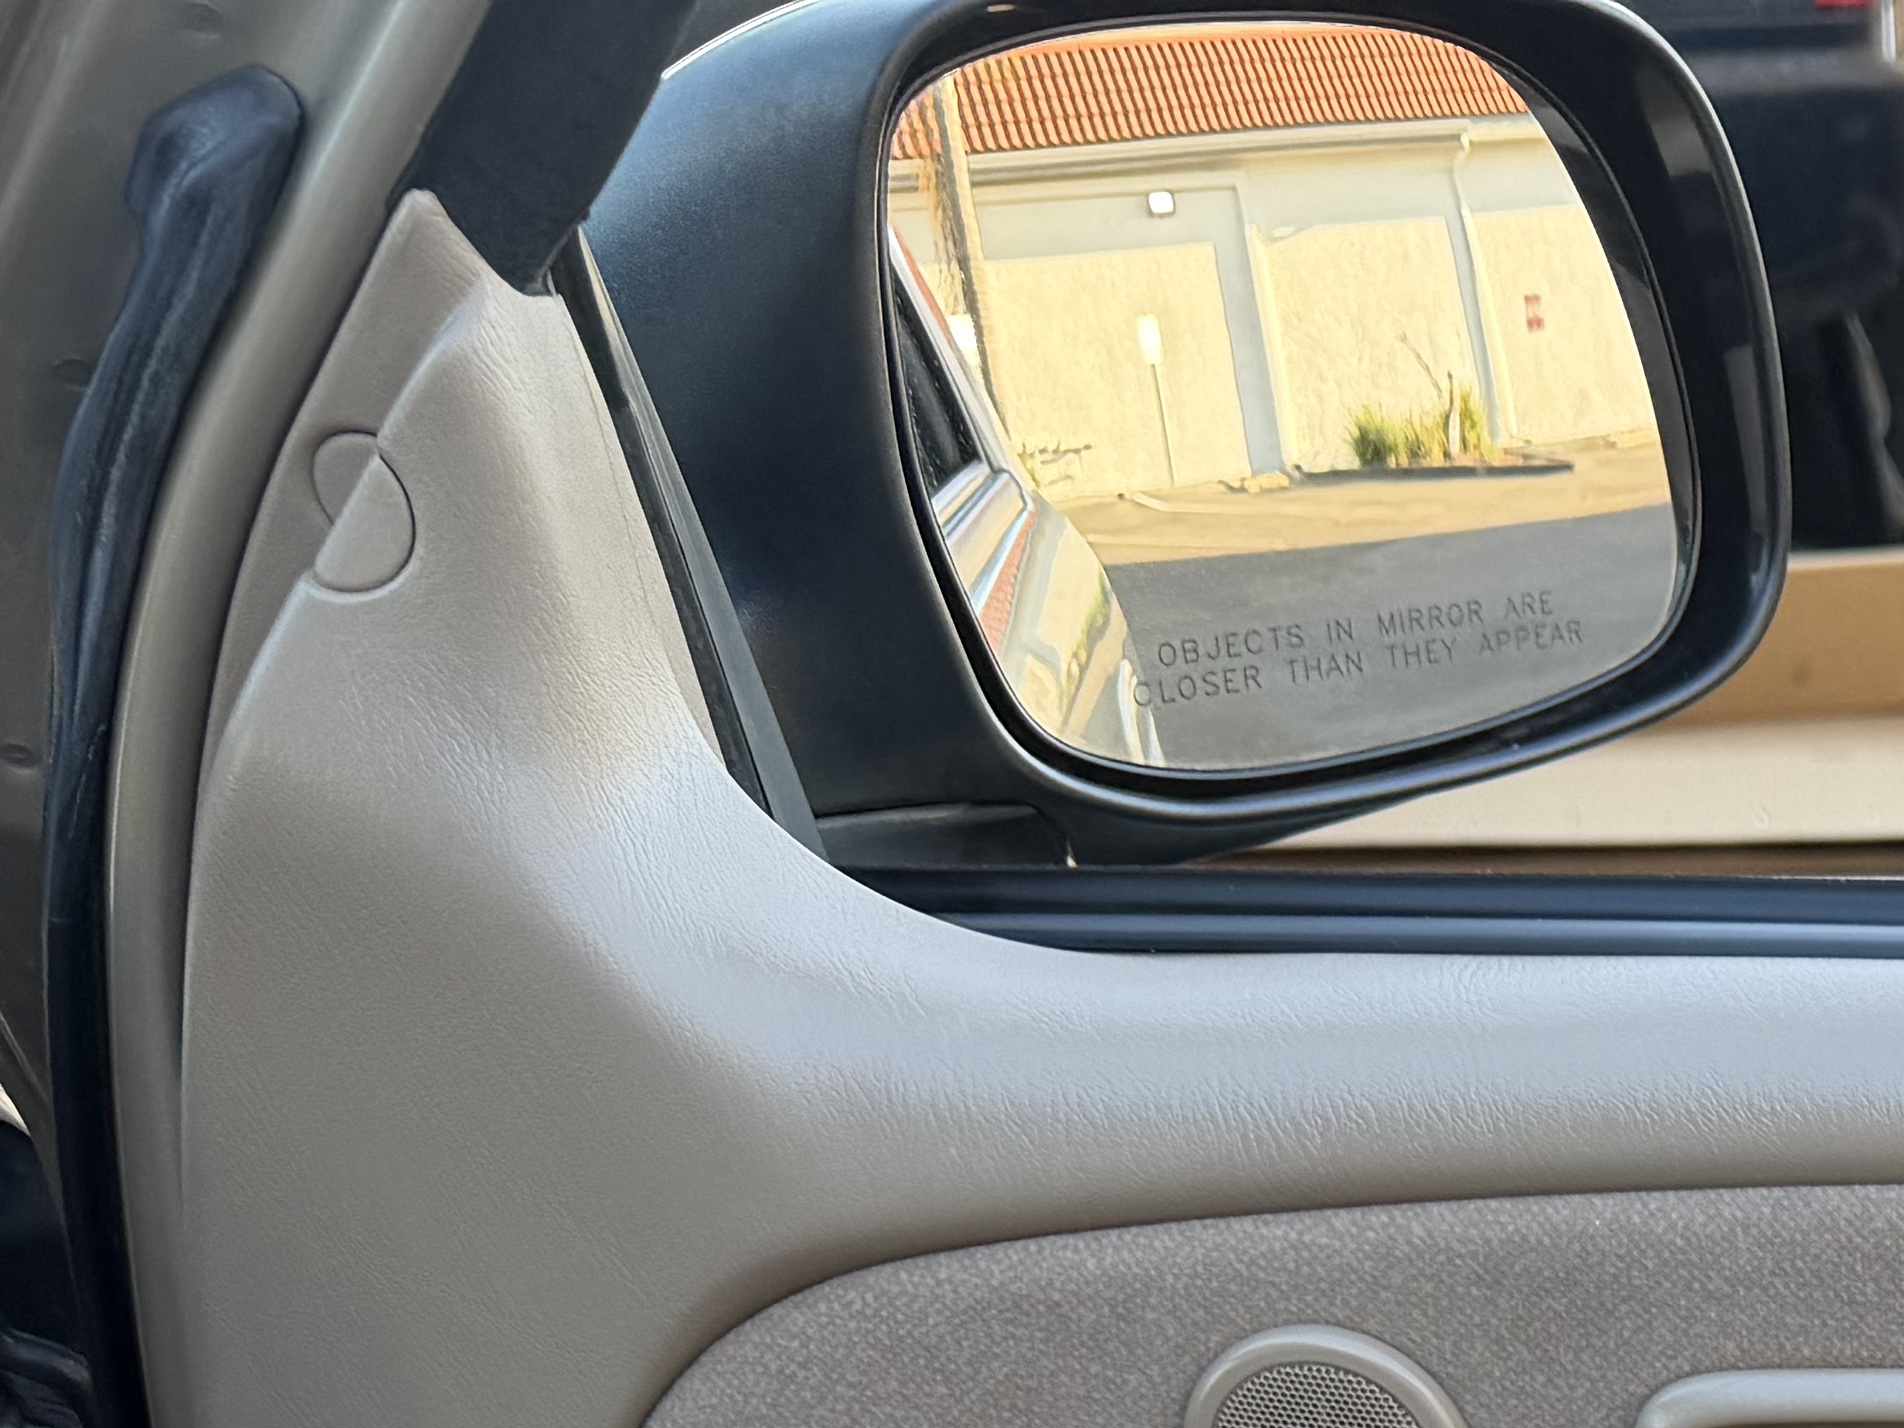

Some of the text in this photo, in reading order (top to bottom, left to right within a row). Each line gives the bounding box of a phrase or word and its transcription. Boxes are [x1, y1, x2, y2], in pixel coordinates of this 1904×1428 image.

[1133, 620, 1583, 707] CLOSER THAN THEY APPEAR
[1158, 590, 1553, 667] OBJECTS IN MIRROR ARE
